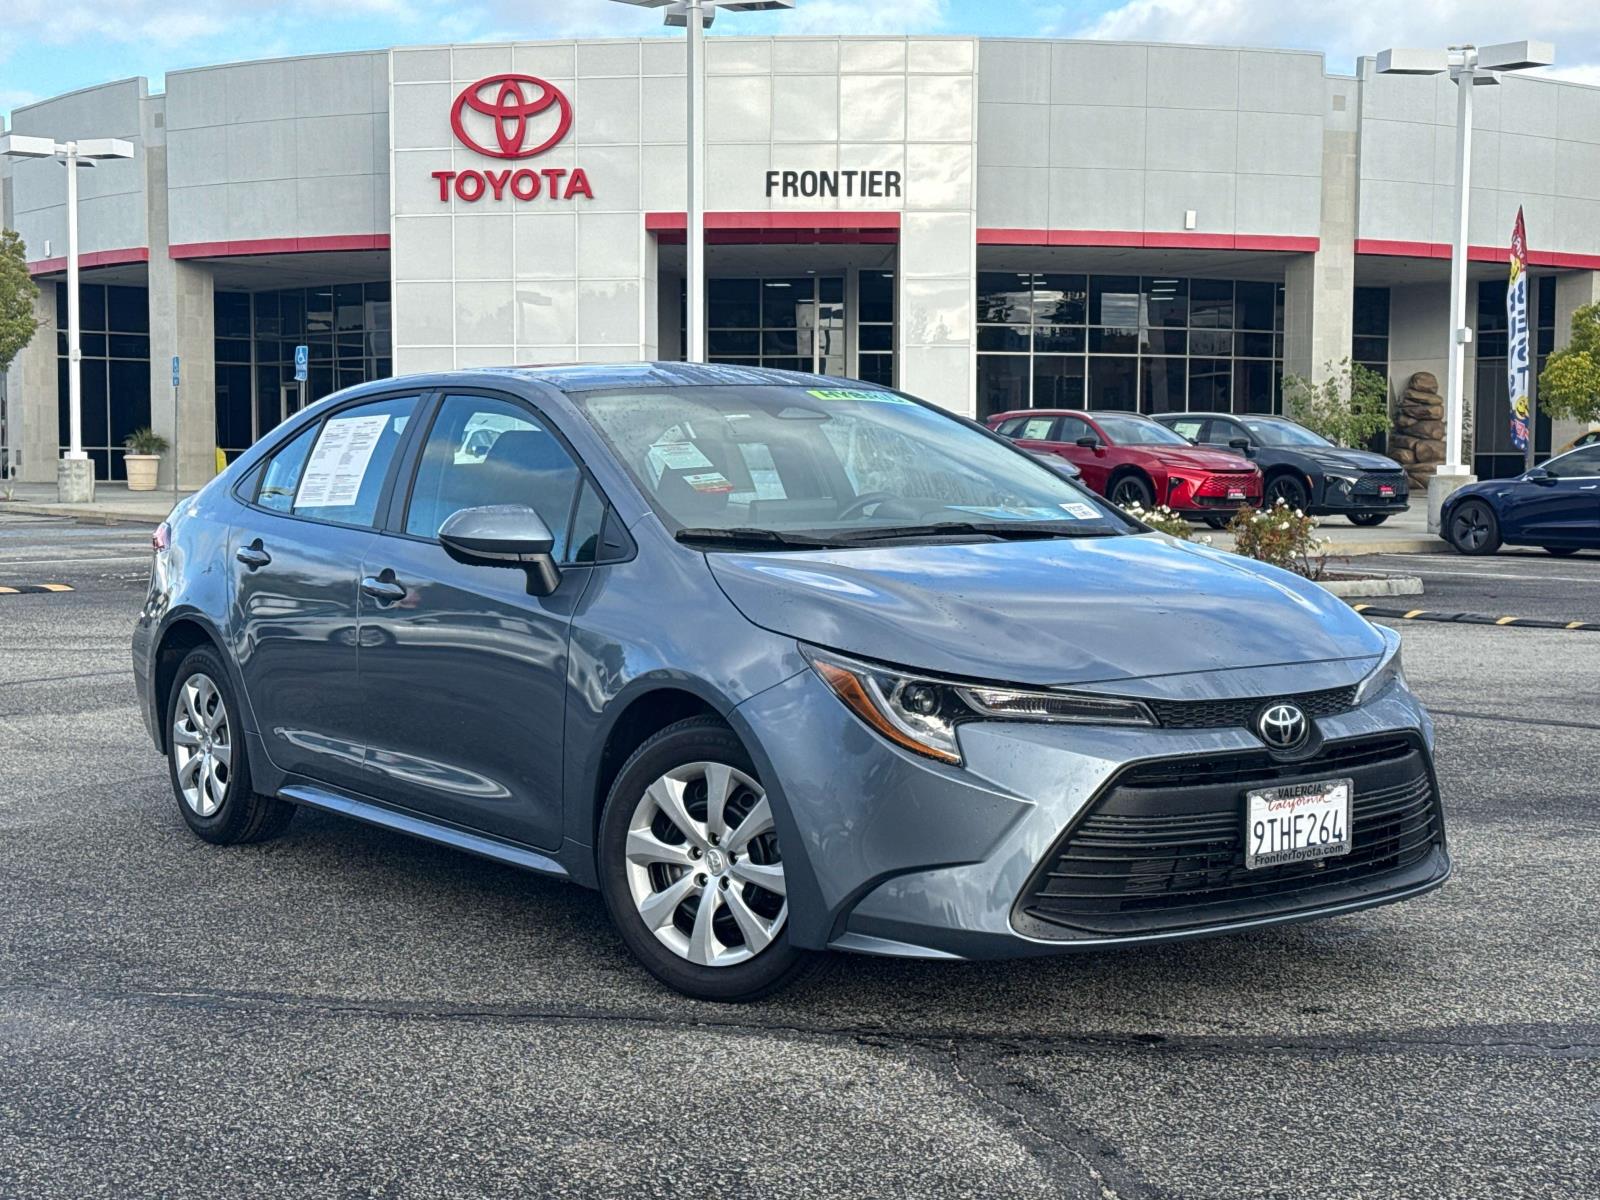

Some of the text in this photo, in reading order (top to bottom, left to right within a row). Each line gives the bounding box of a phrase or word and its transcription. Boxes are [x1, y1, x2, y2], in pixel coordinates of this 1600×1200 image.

[432, 168, 593, 202] TOYOTA
[765, 170, 902, 198] FRONTIER
[1278, 784, 1323, 798] VALENCIA
[1253, 809, 1343, 855] 9THF264
[1254, 844, 1344, 866] FrontierToyota.com
